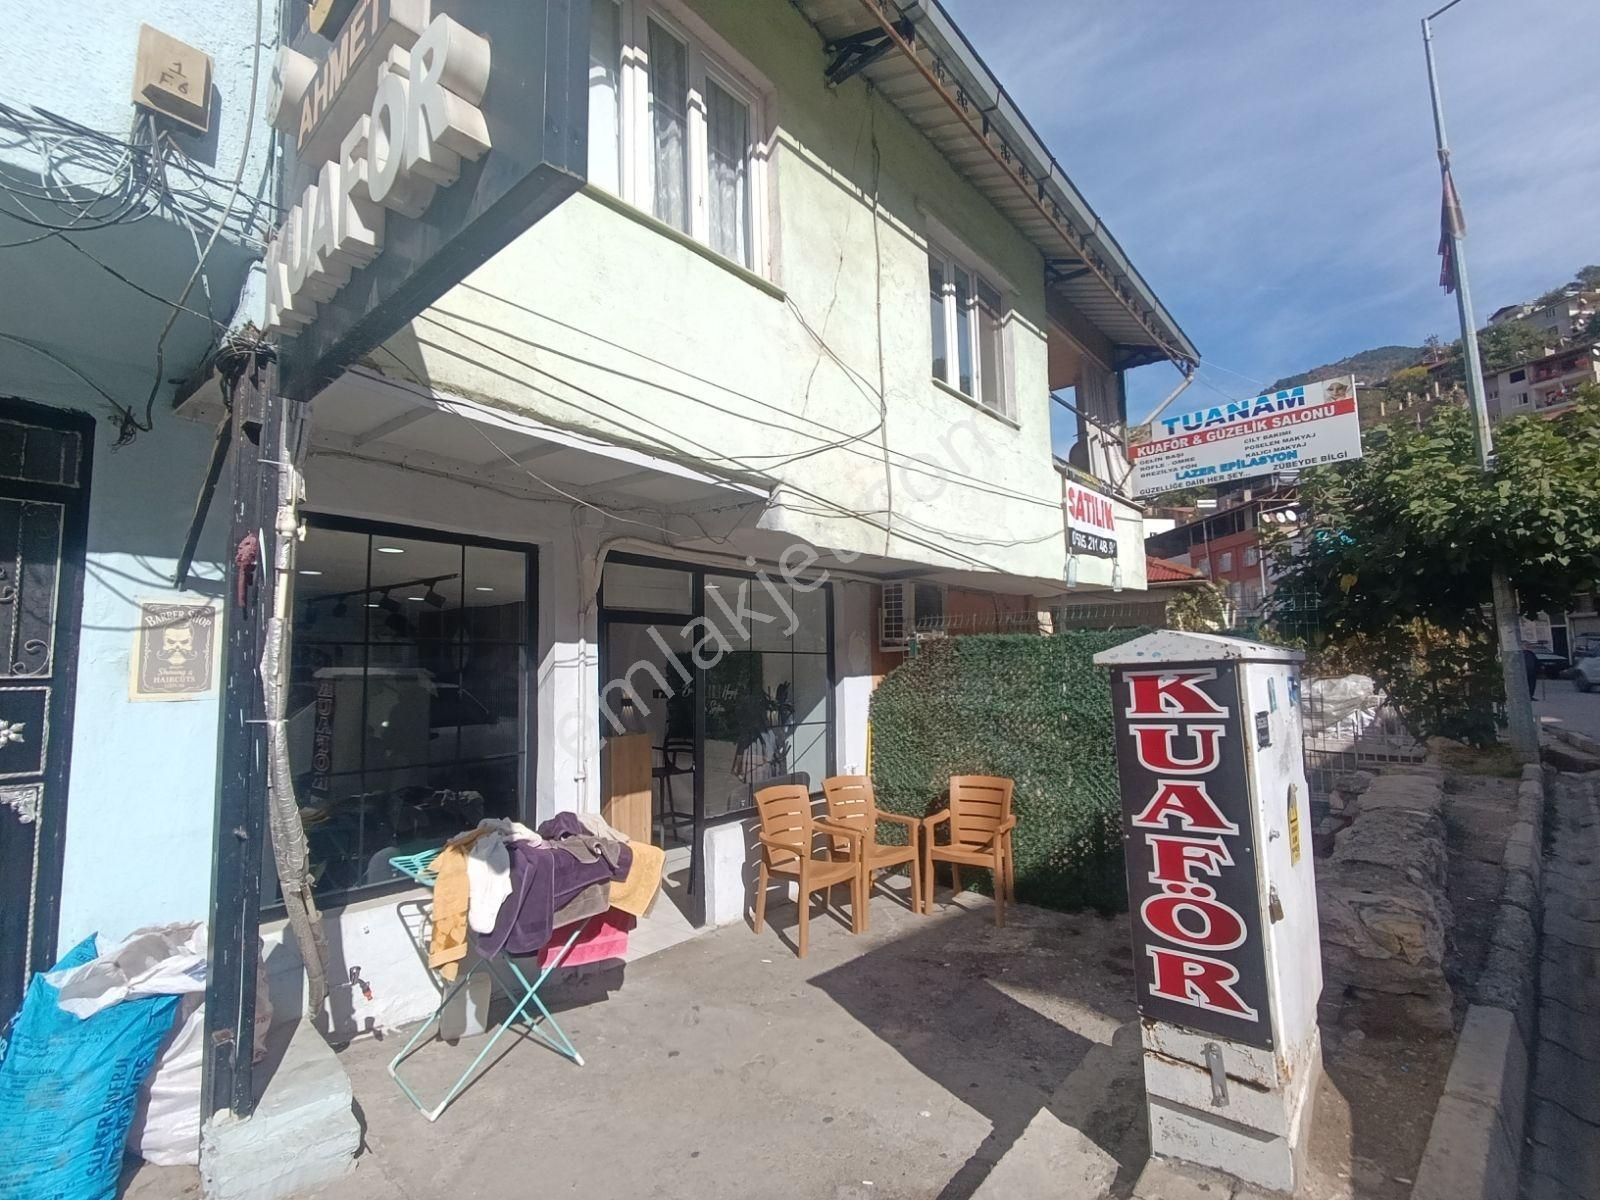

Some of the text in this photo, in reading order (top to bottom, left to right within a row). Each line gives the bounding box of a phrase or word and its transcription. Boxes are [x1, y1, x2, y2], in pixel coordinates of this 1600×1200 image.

[1161, 386, 1305, 436] TUANAM
[1193, 434, 1203, 445] &
[1272, 404, 1335, 428] SALONU
[1273, 442, 1307, 452] MAKYAJ
[1282, 433, 1316, 443] MAKYAJ
[1175, 450, 1298, 481] LAZER EPİLASYON
[1207, 475, 1225, 483] HER
[1068, 486, 1115, 531] SATILIK
[1122, 667, 1259, 1023] KUAFÖR
